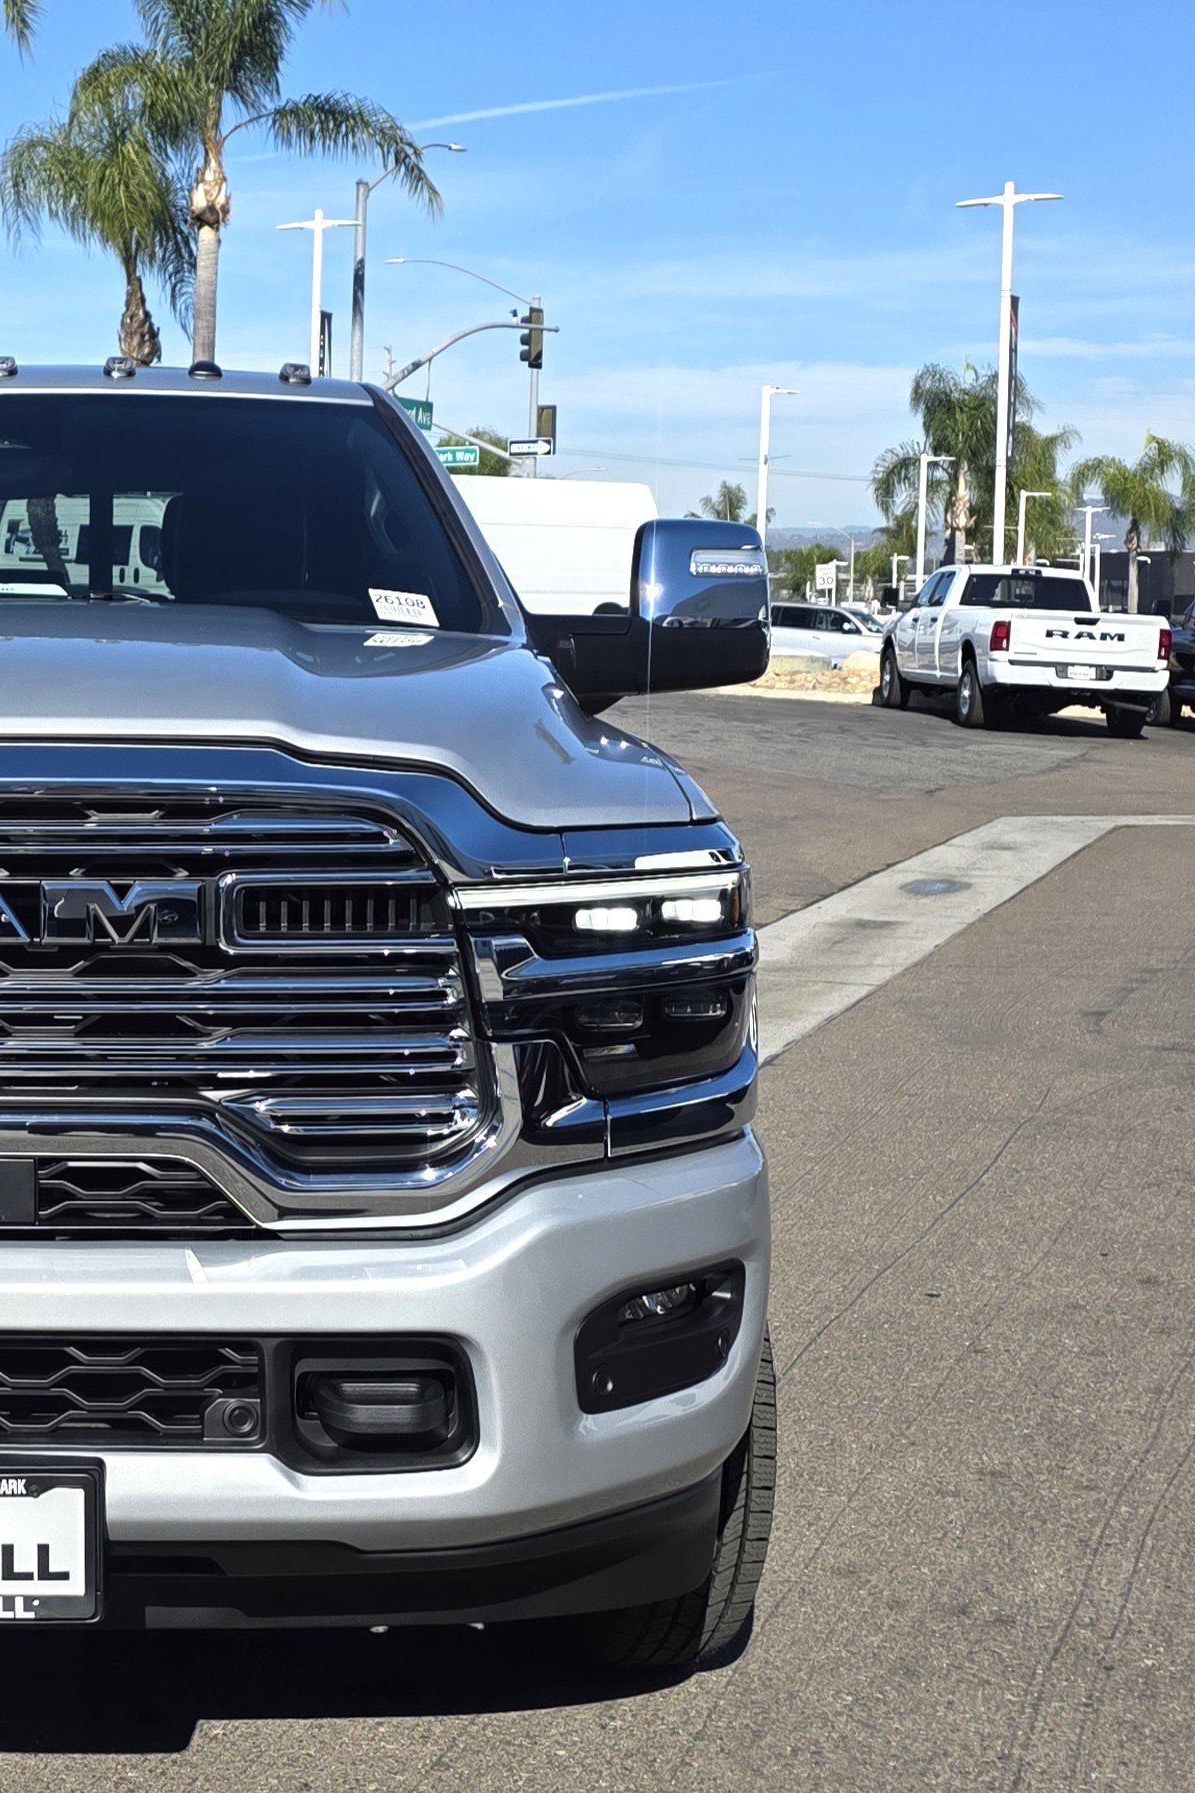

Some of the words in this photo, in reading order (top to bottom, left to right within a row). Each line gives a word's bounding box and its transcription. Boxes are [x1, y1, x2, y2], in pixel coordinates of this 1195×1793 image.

[436, 451, 453, 462] ark
[455, 450, 476, 462] Way
[819, 576, 834, 586] 30
[374, 594, 426, 609] 26108
[1045, 629, 1126, 642] RAM
